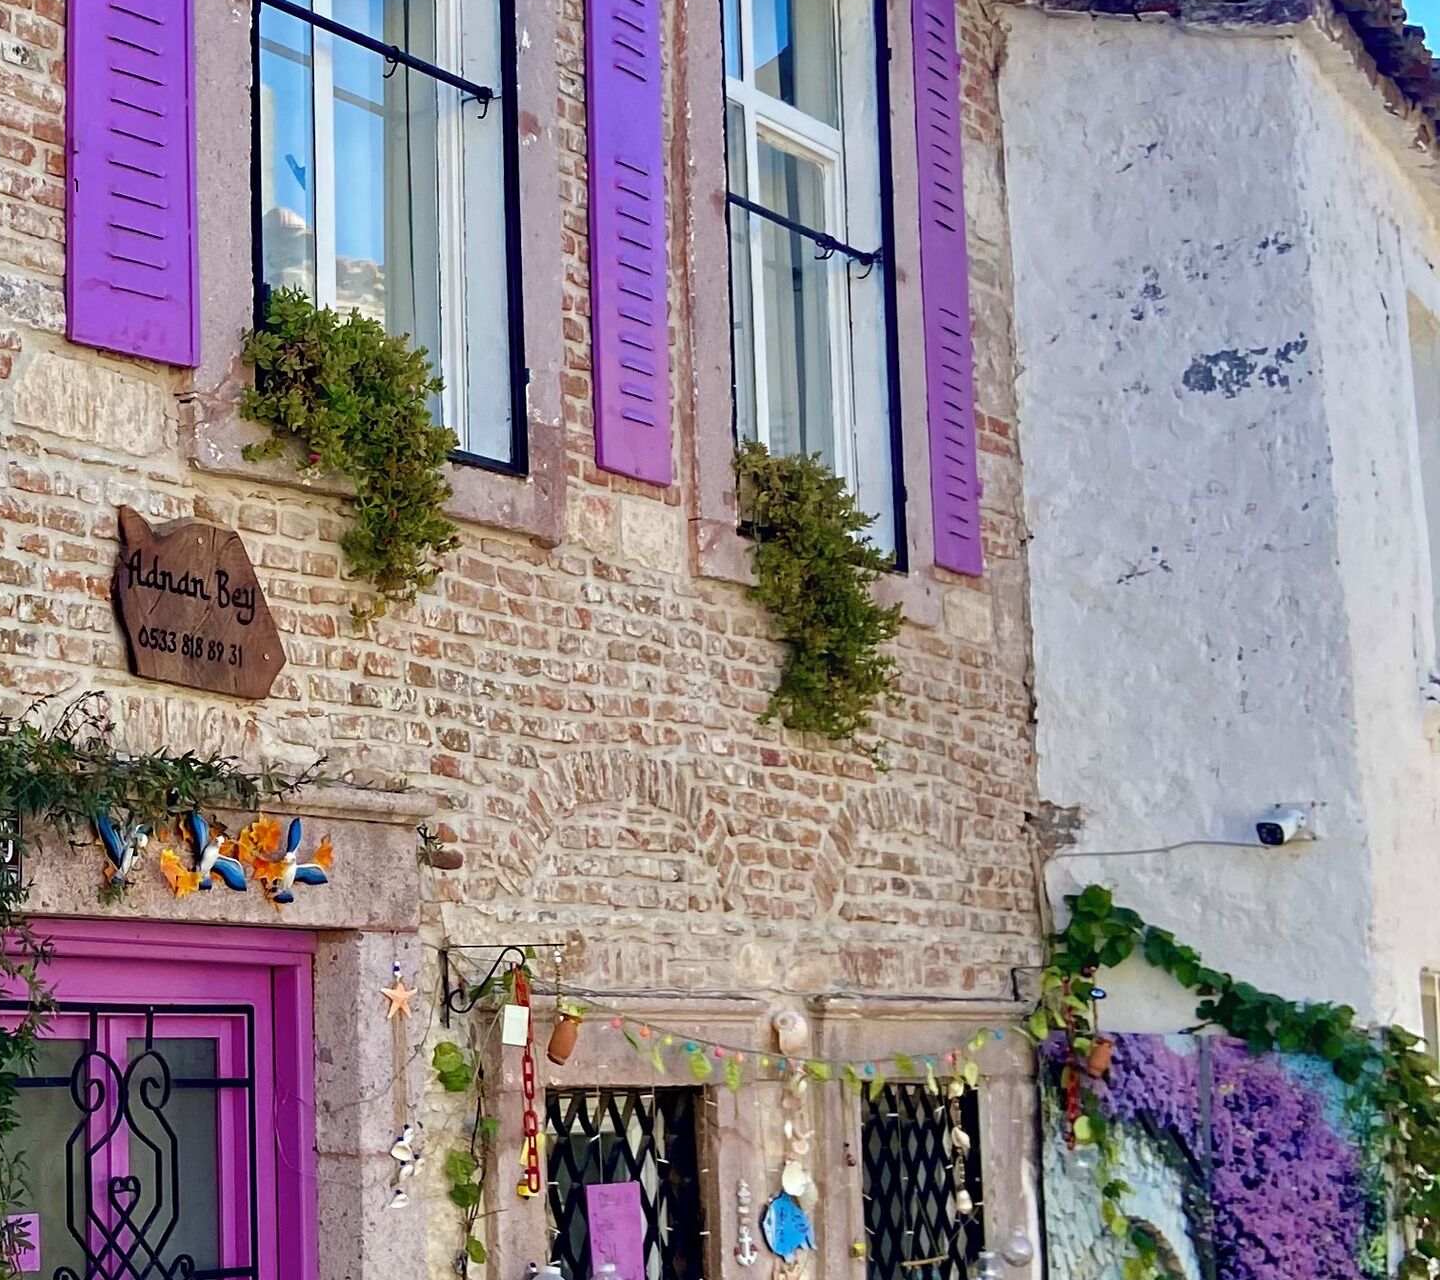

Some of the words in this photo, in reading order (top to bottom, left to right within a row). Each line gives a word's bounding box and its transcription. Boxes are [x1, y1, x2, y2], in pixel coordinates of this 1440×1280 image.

[120, 548, 211, 601] Adnan
[215, 569, 256, 626] Bey
[138, 624, 177, 654] 0533
[181, 633, 203, 659] 818
[207, 640, 225, 662] 89
[228, 644, 243, 669] 31
